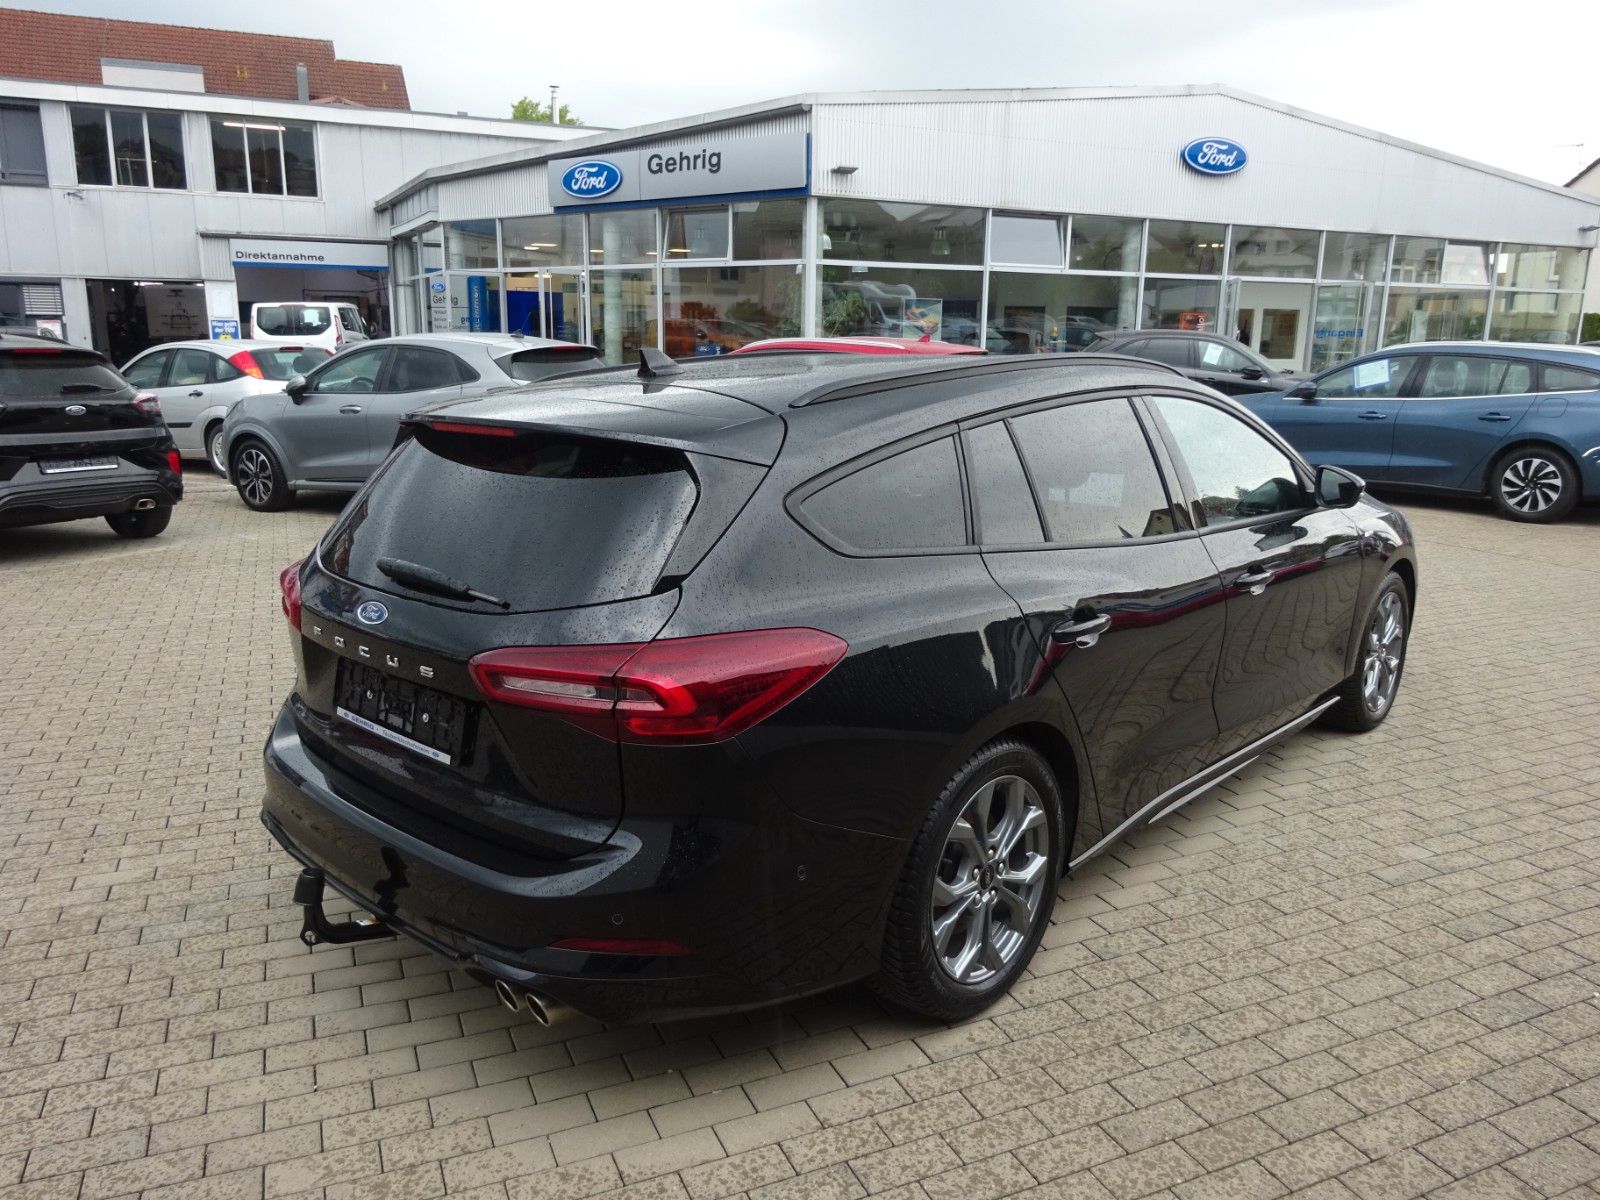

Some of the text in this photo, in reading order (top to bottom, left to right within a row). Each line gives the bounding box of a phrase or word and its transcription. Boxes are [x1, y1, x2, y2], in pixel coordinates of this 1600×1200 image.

[648, 149, 721, 175] Gehrig
[1198, 142, 1237, 167] Ford
[571, 166, 608, 191] Ford
[235, 250, 325, 262] Direktannahme
[432, 295, 459, 306] Gehig
[313, 625, 434, 679] FOCUS
